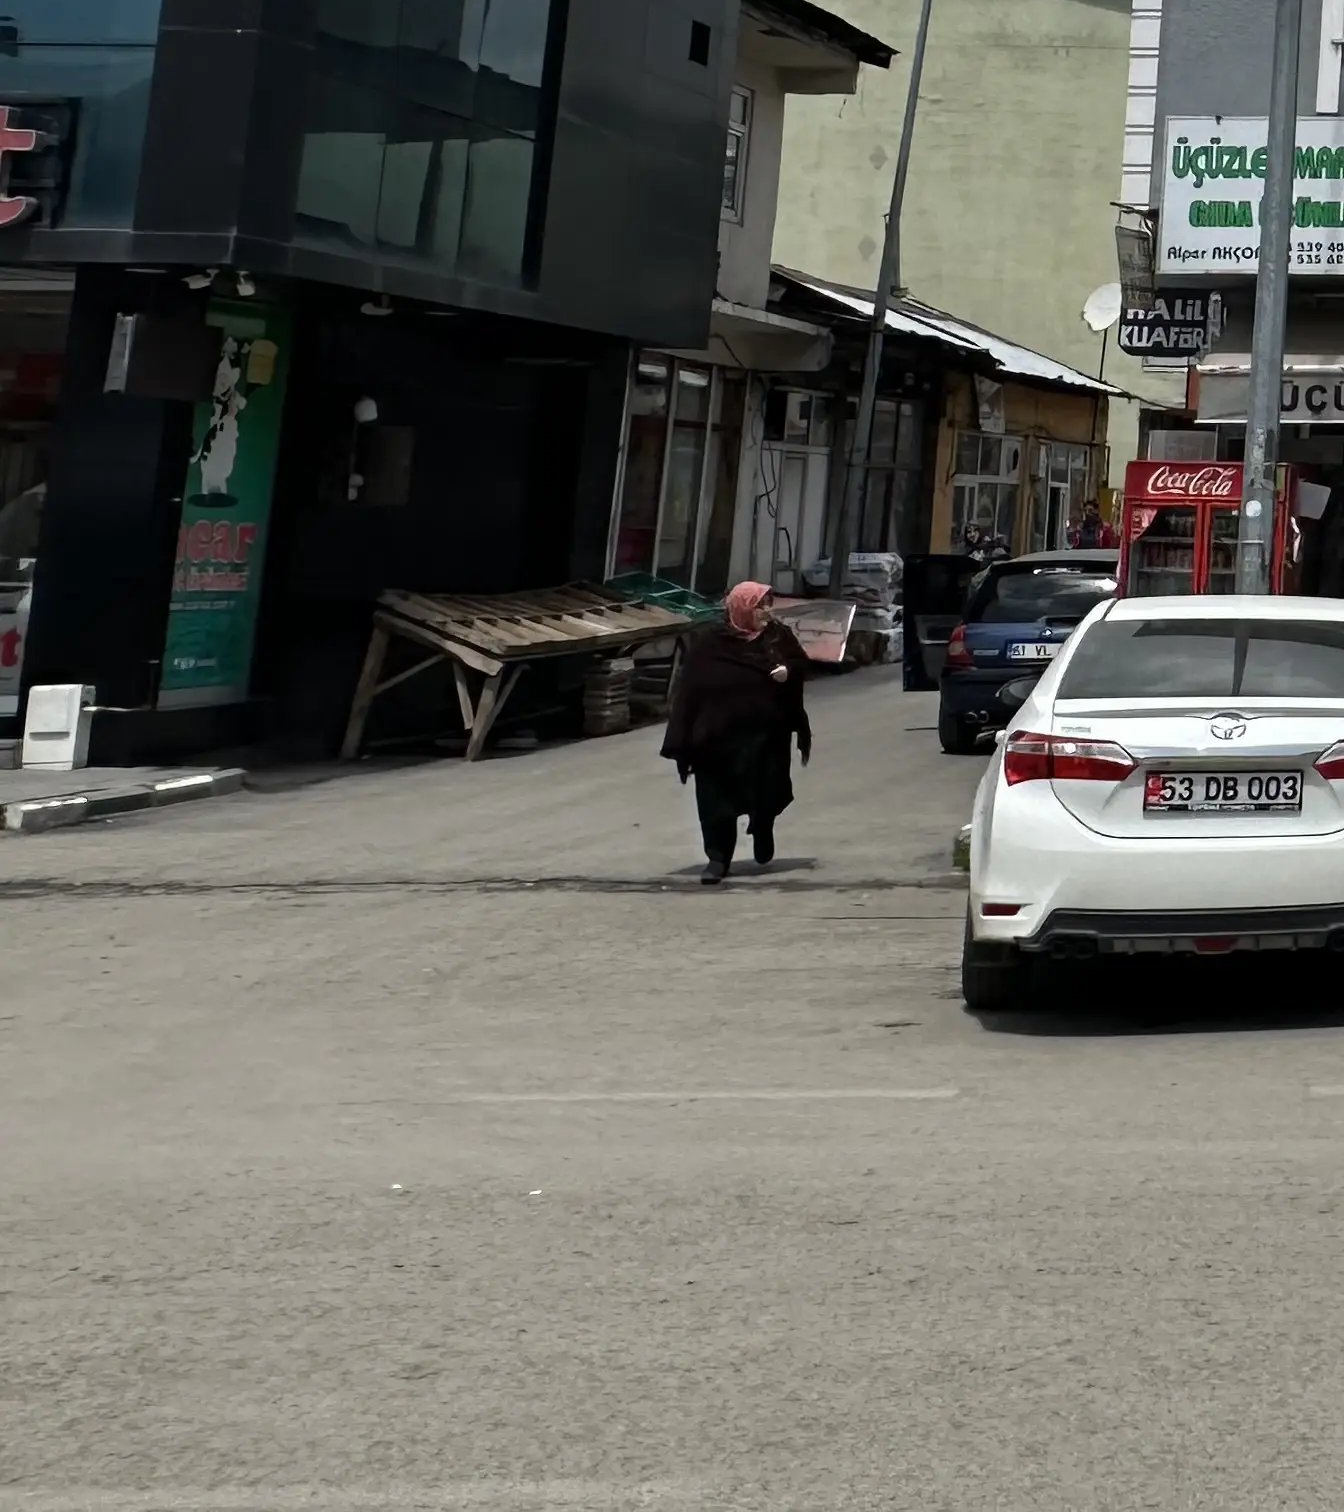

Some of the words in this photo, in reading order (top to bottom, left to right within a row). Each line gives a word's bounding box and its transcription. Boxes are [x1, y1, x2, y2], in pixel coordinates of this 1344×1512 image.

[1172, 137, 1267, 188] ÜÇÜZLE
[1161, 776, 1194, 801] 53
[1204, 776, 1239, 801] DB
[1247, 776, 1299, 801] 003
